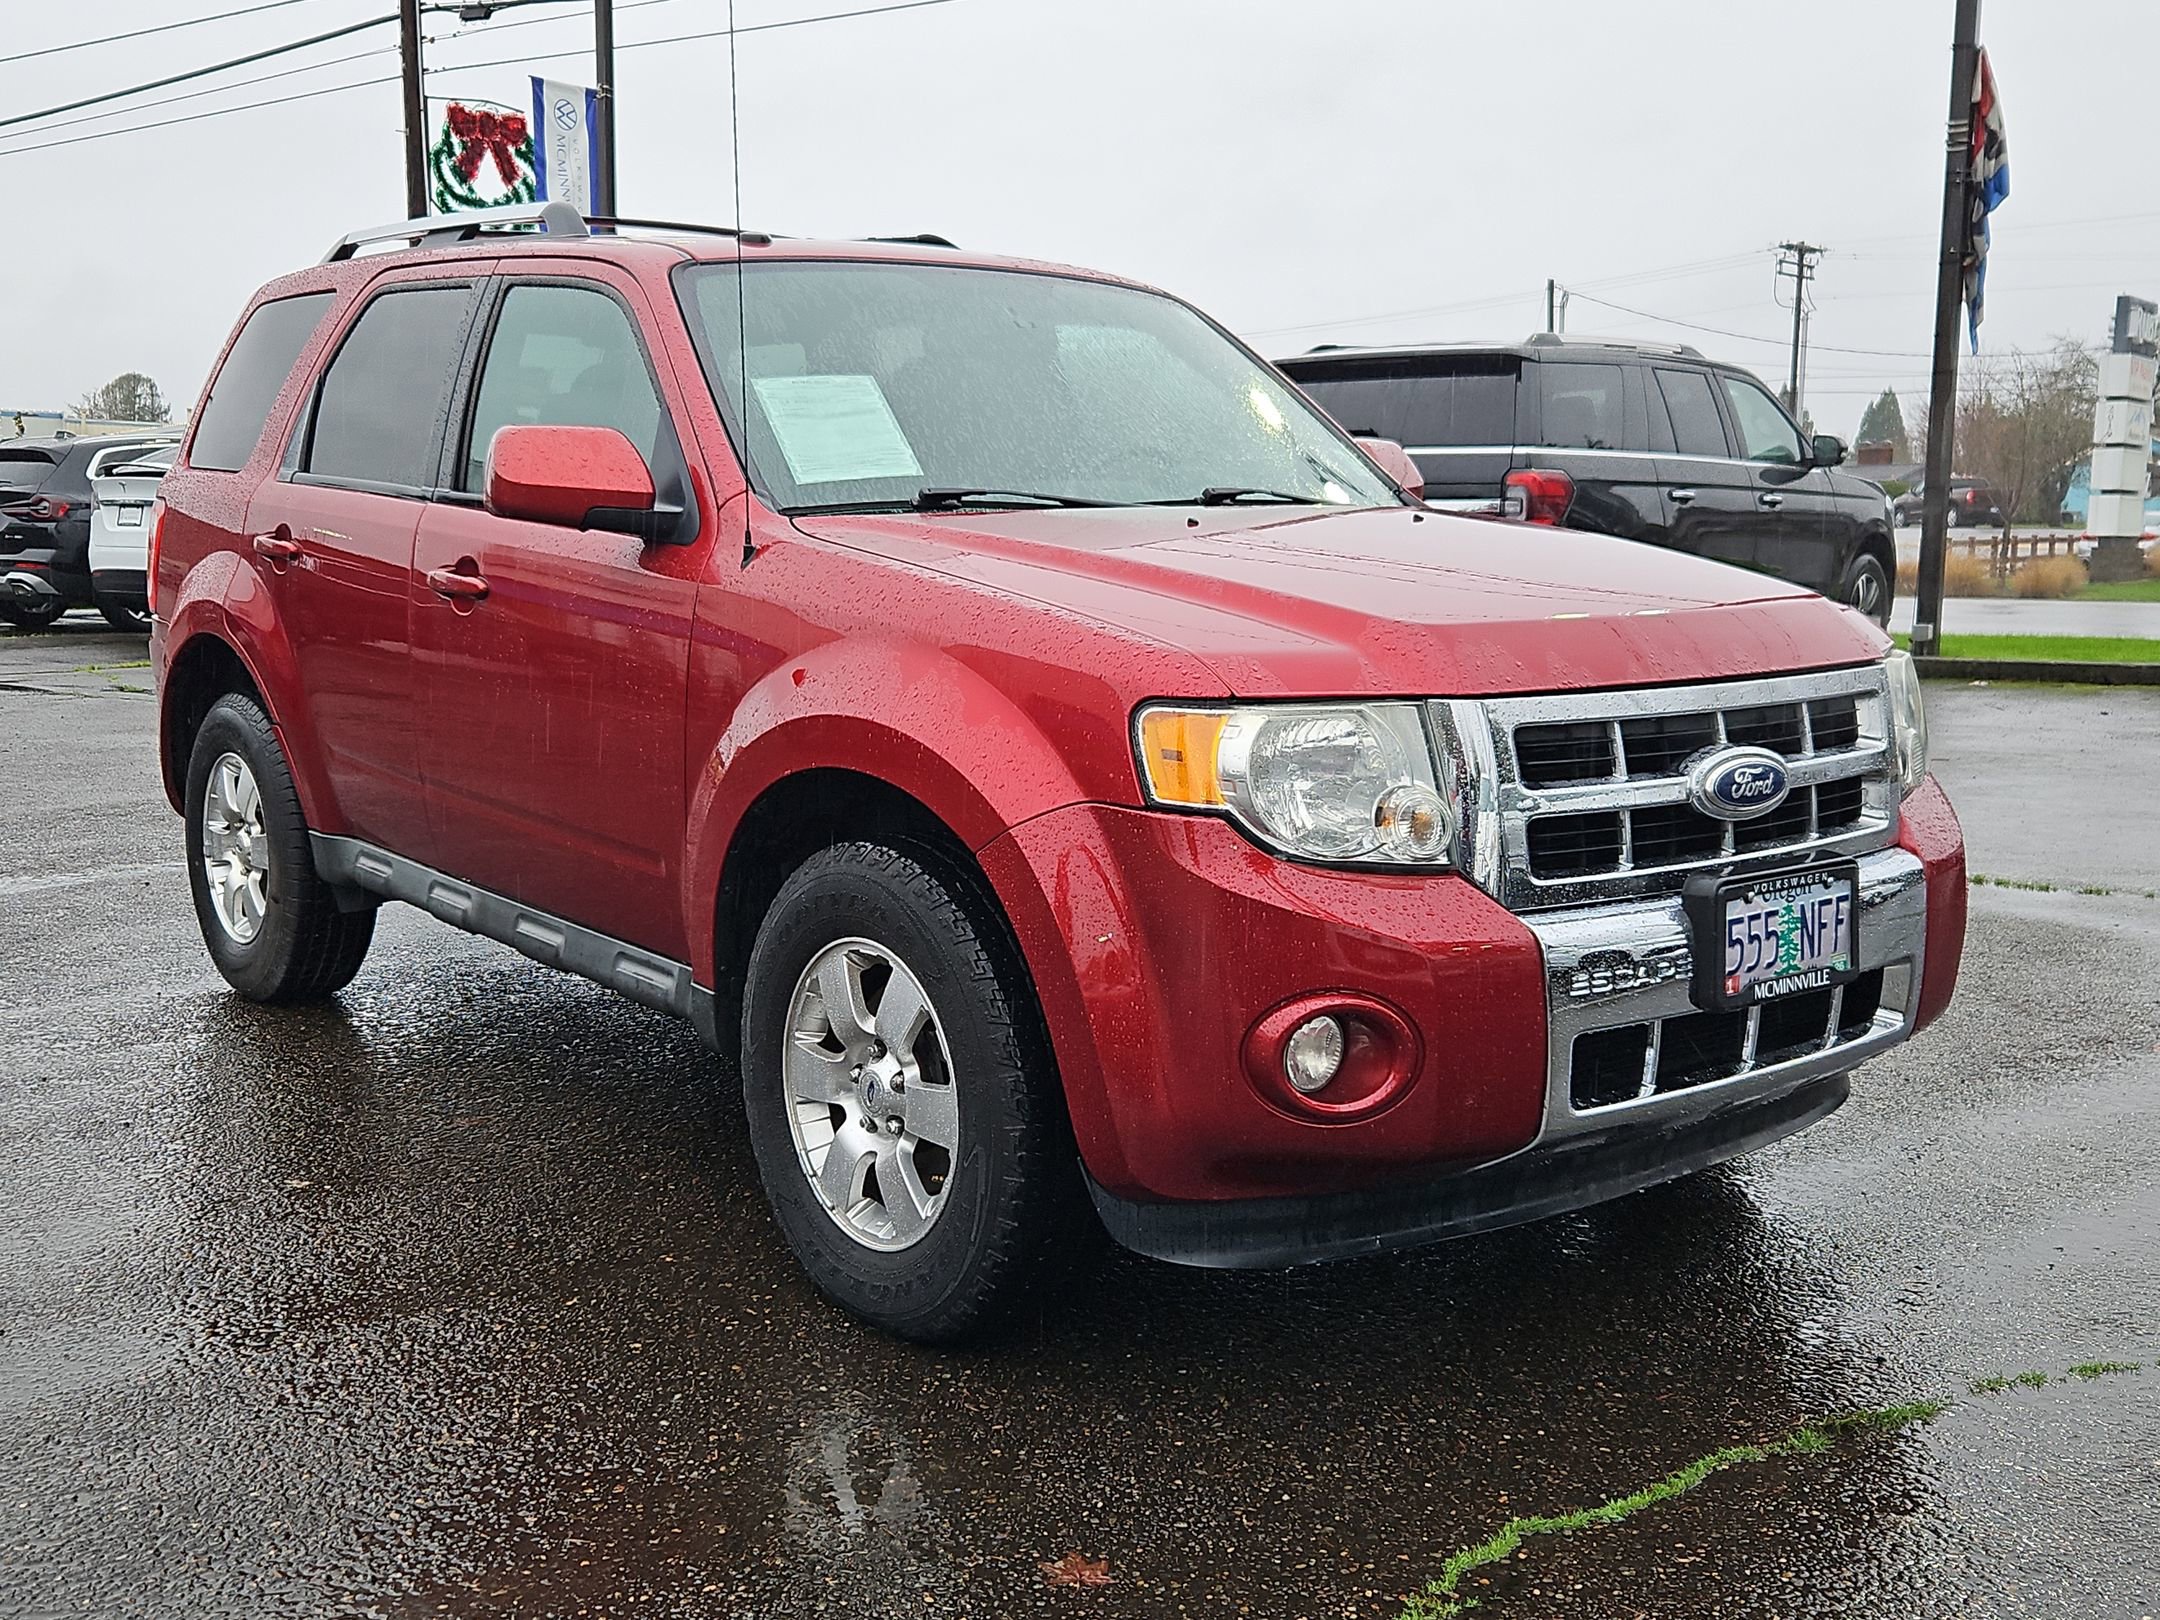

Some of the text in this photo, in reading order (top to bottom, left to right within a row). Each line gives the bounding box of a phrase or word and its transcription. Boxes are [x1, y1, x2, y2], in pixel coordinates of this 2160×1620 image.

[1731, 767, 1775, 799] Ford
[1753, 872, 1829, 894] VOLKSWAGEN
[1726, 894, 1850, 976] 555 NFF
[1754, 968, 1831, 1000] MCMINNVILLE
